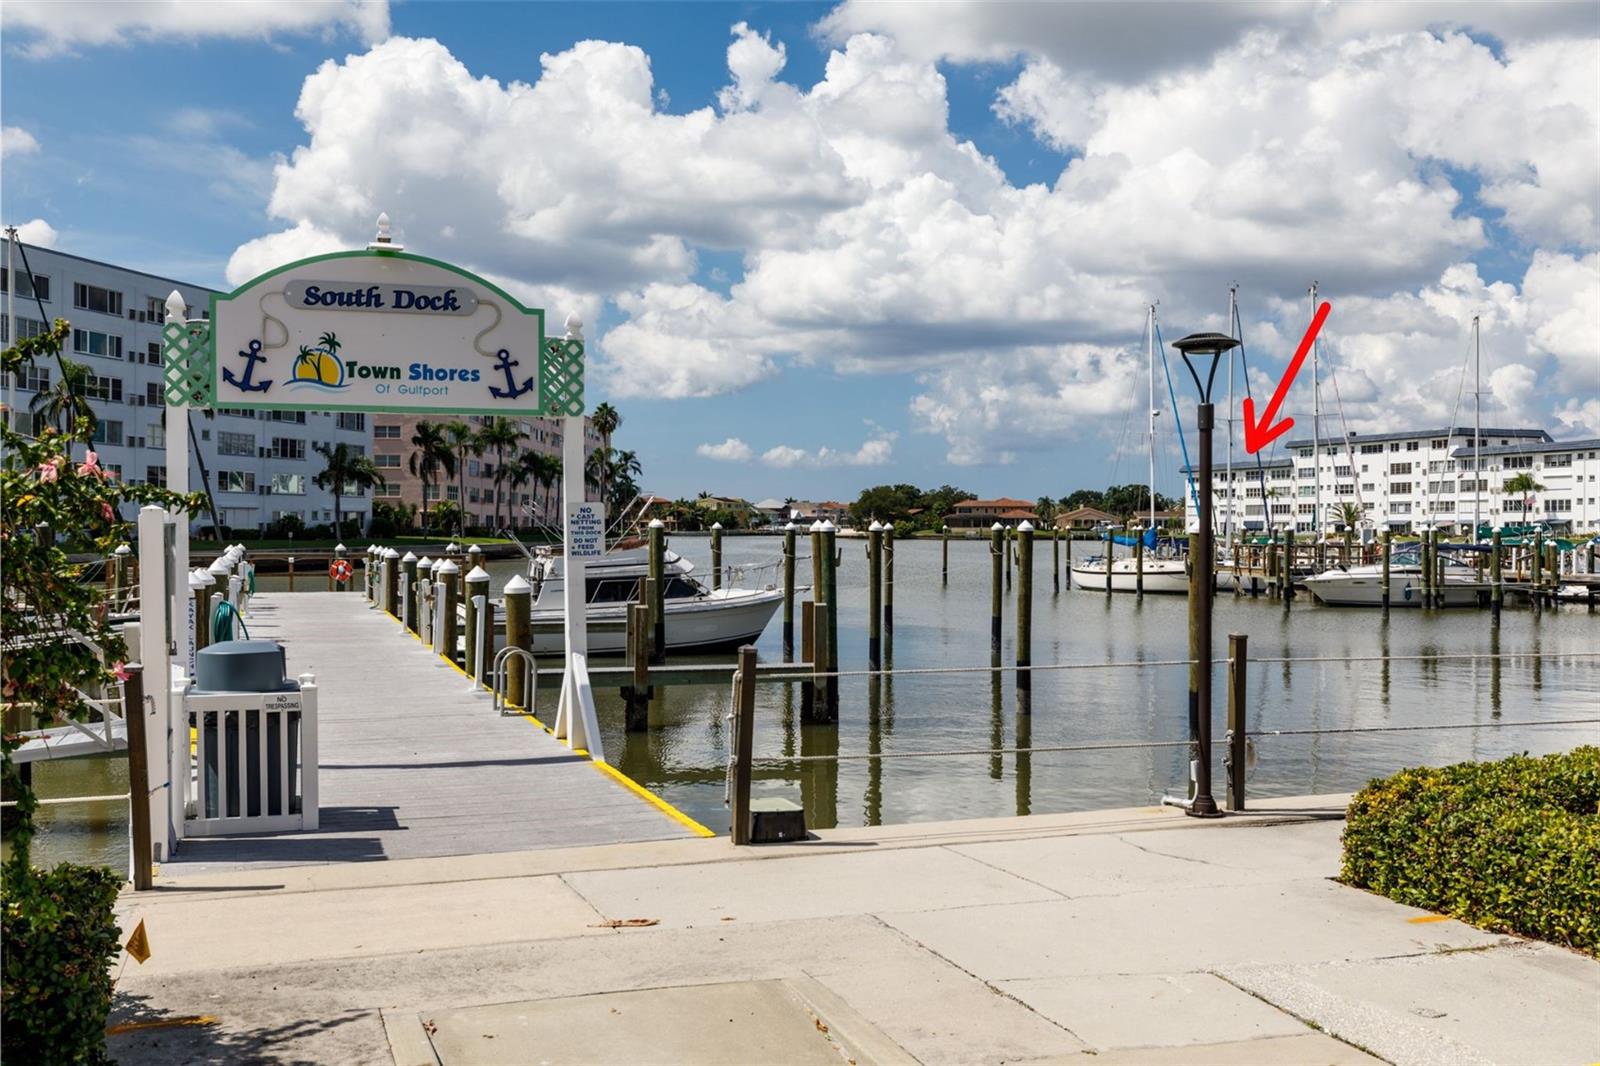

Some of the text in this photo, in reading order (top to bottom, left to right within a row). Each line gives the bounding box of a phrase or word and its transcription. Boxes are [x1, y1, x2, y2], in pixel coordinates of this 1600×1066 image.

[303, 286, 461, 311] South Dock
[345, 361, 480, 382] Town Shores
[375, 383, 448, 397] Of Gulfport
